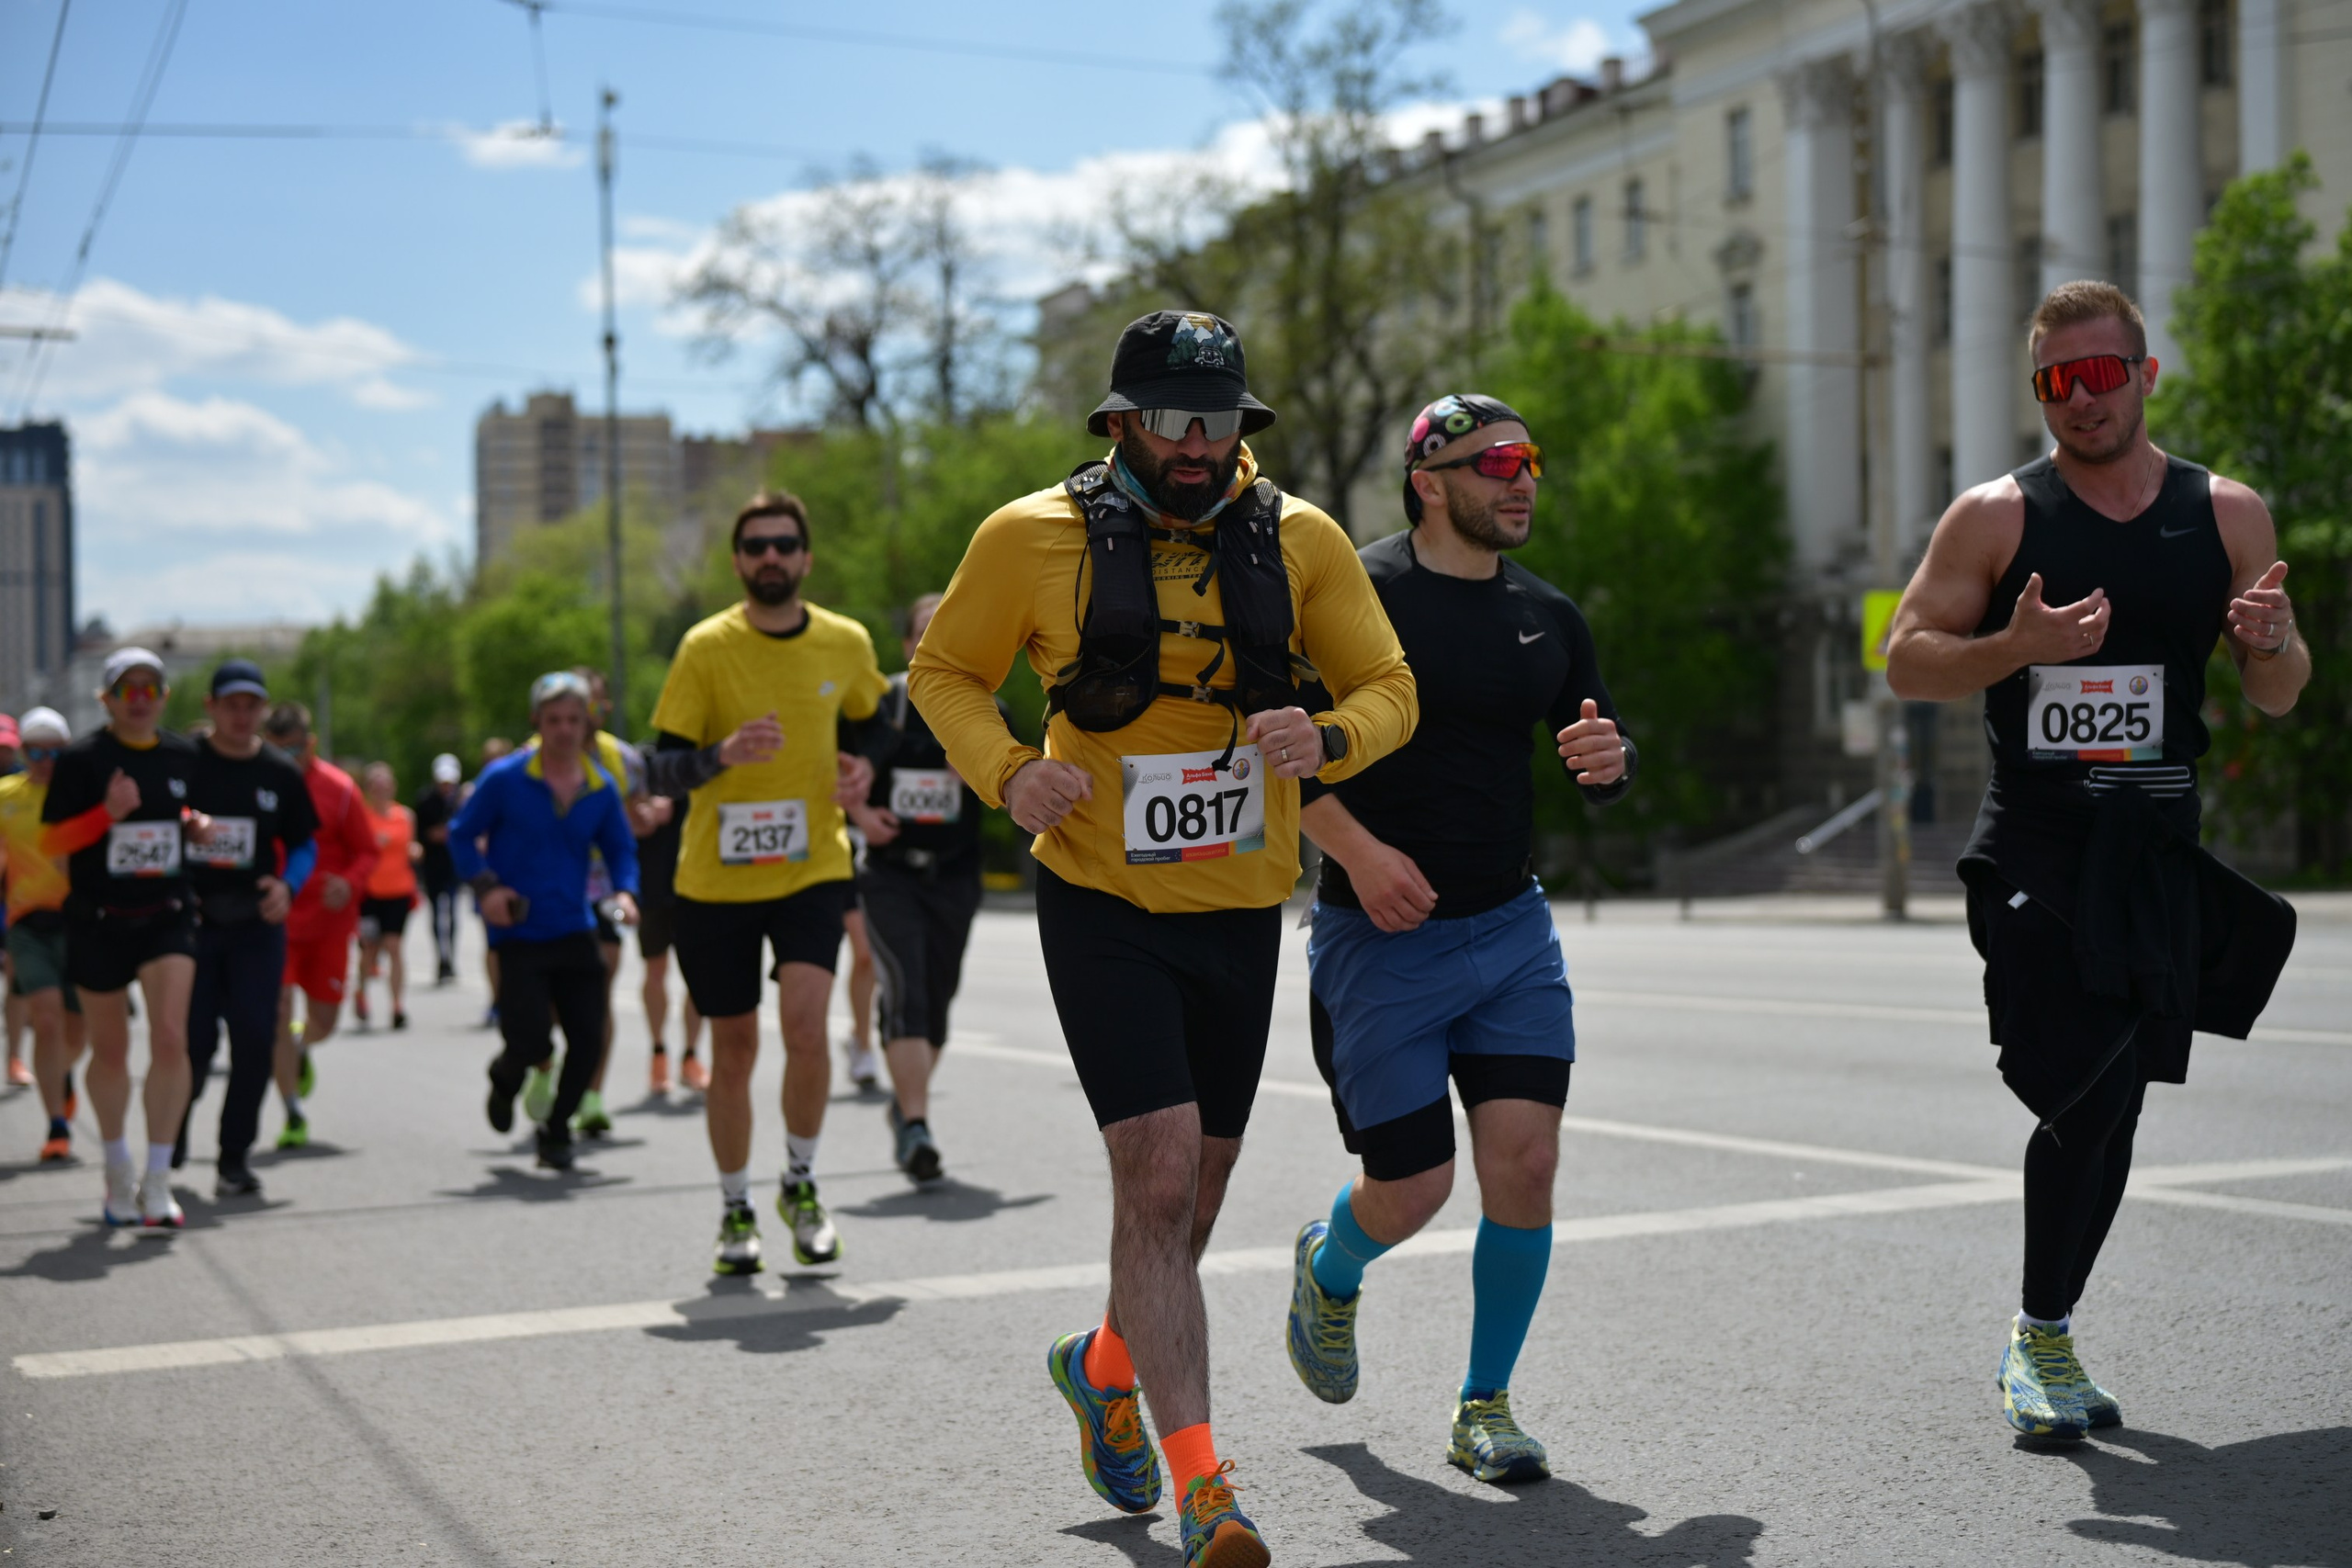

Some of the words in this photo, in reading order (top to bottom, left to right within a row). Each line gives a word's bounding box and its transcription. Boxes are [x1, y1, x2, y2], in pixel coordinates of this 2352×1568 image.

[2041, 702, 2151, 744] 0825
[1146, 787, 1249, 842] 0817
[733, 824, 795, 852] 2137
